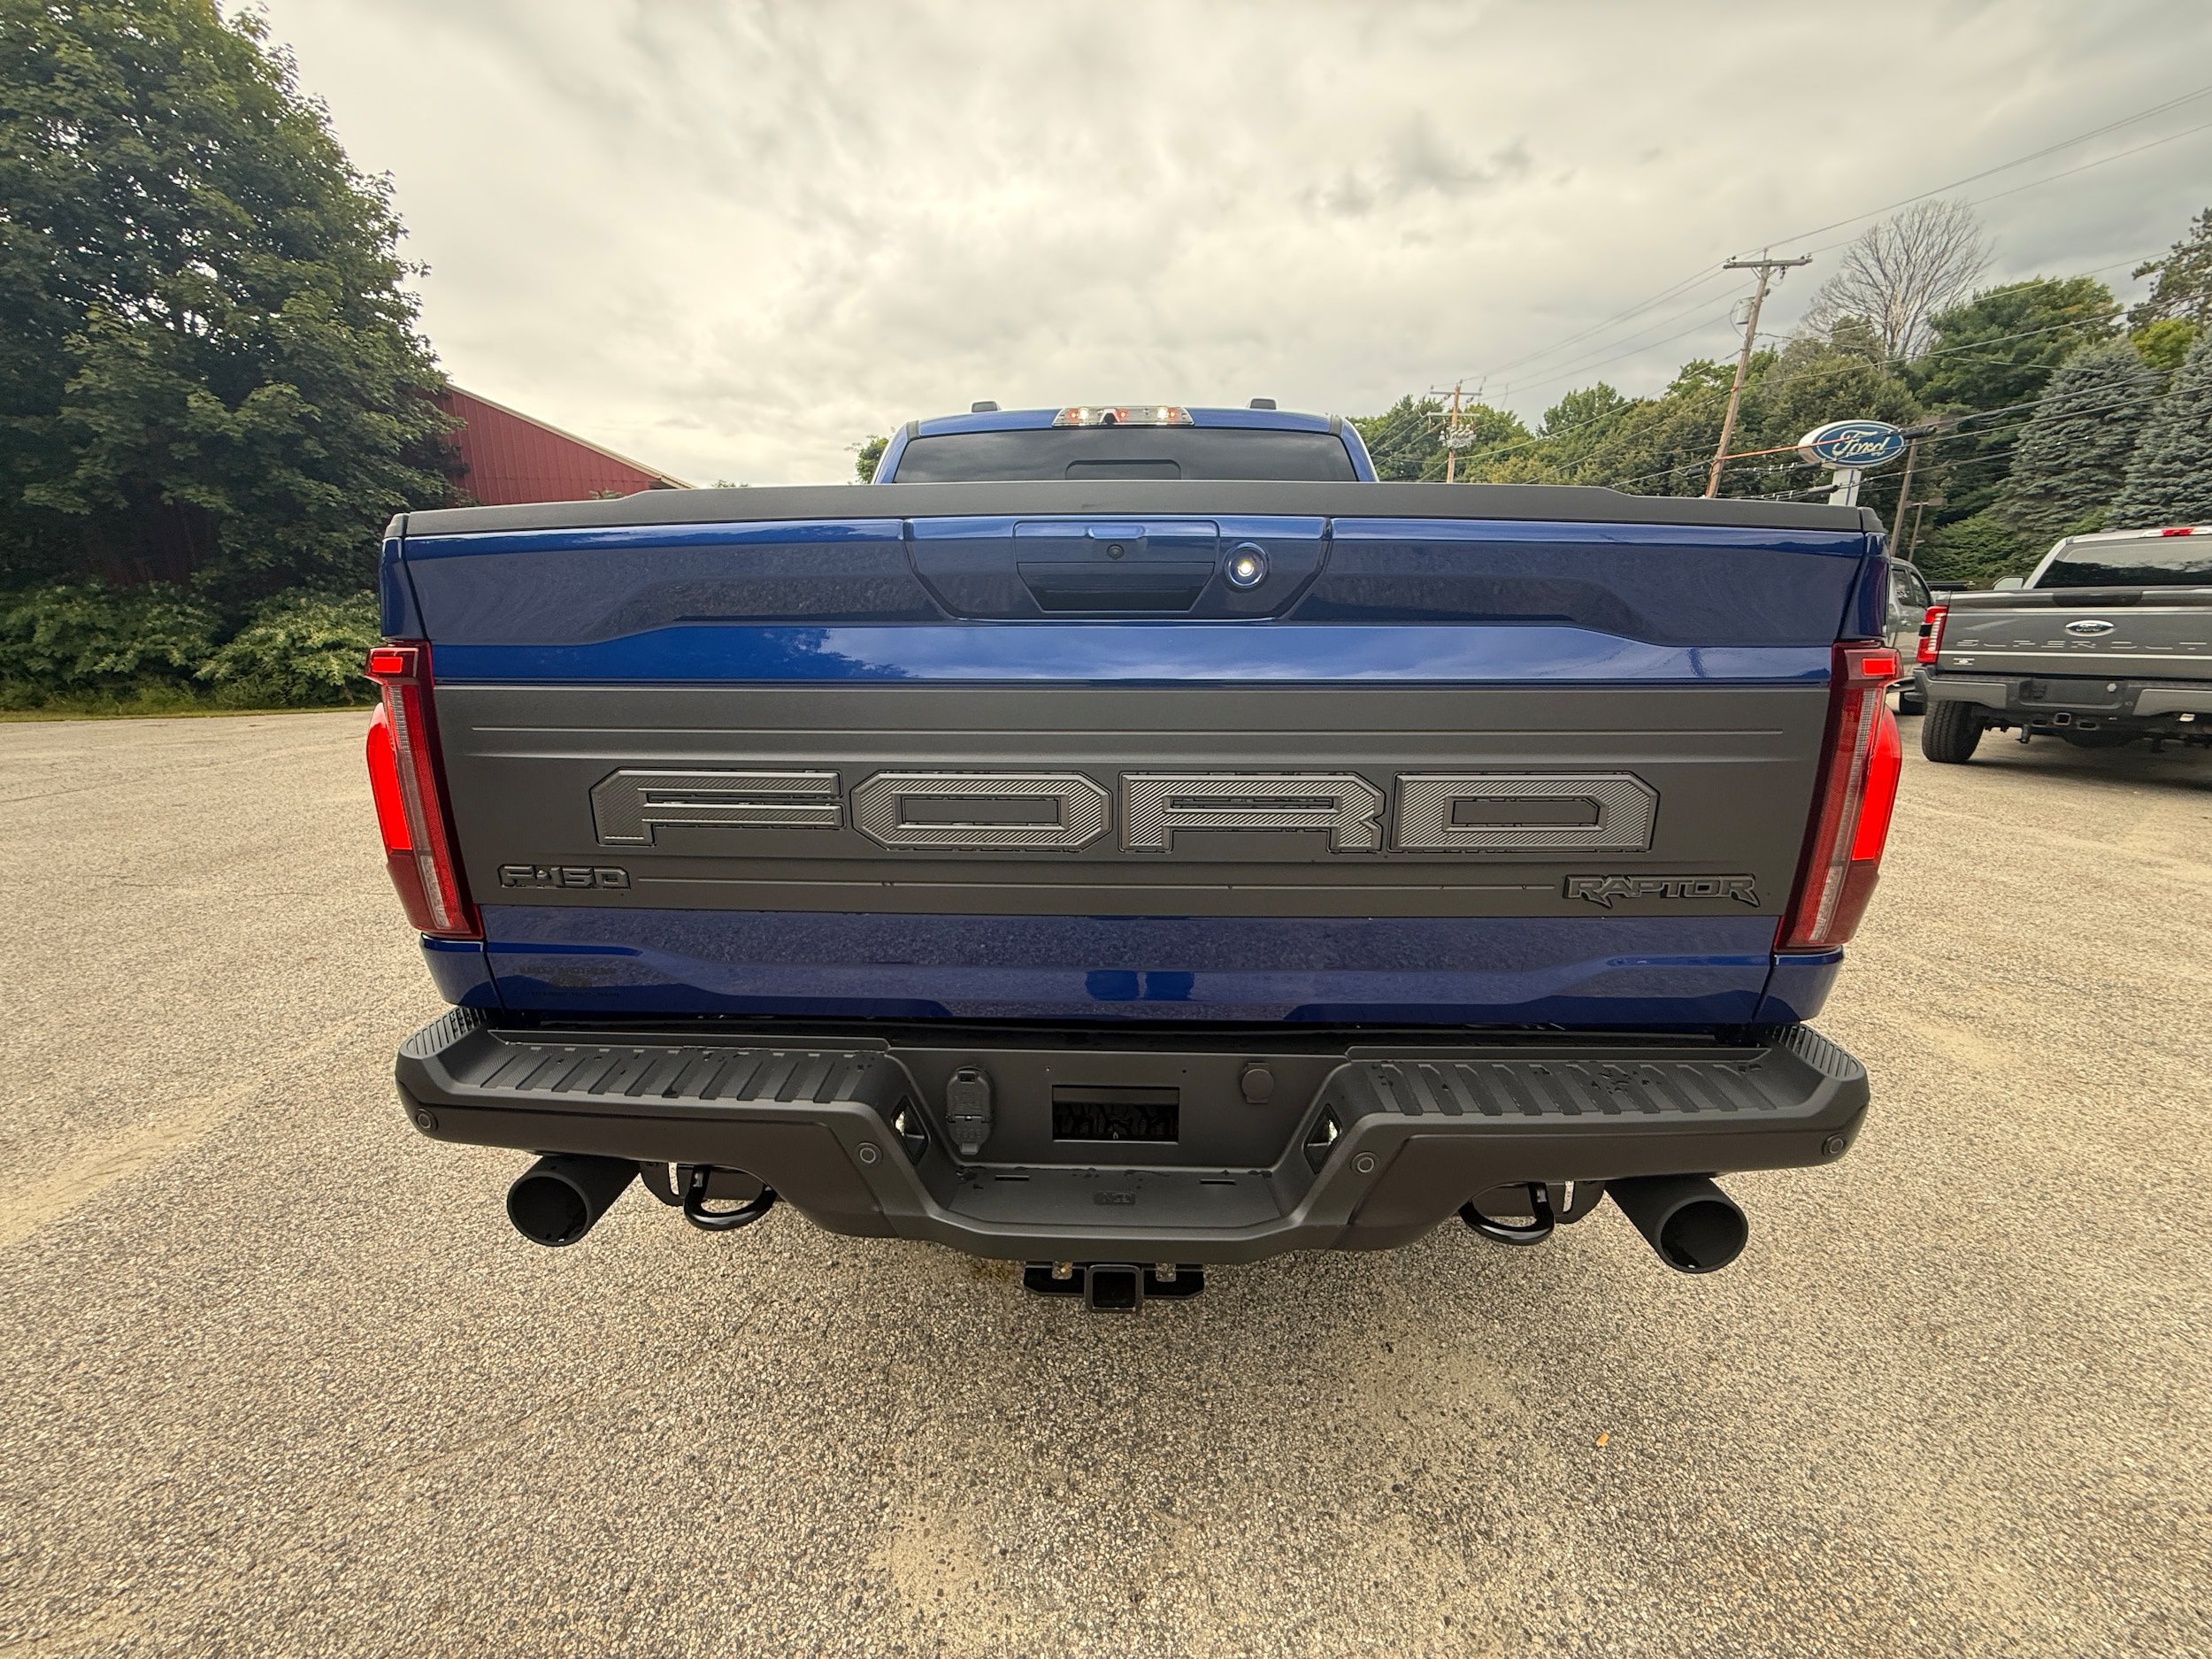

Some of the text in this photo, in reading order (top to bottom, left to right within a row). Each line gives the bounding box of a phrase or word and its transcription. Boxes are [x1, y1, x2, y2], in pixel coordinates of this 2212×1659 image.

[1832, 429, 1891, 457] Ford
[1955, 639, 2208, 650] SUPER DUT
[590, 767, 1661, 853] FORD
[497, 864, 631, 889] F-150
[1563, 874, 1761, 909] RAPTOR
